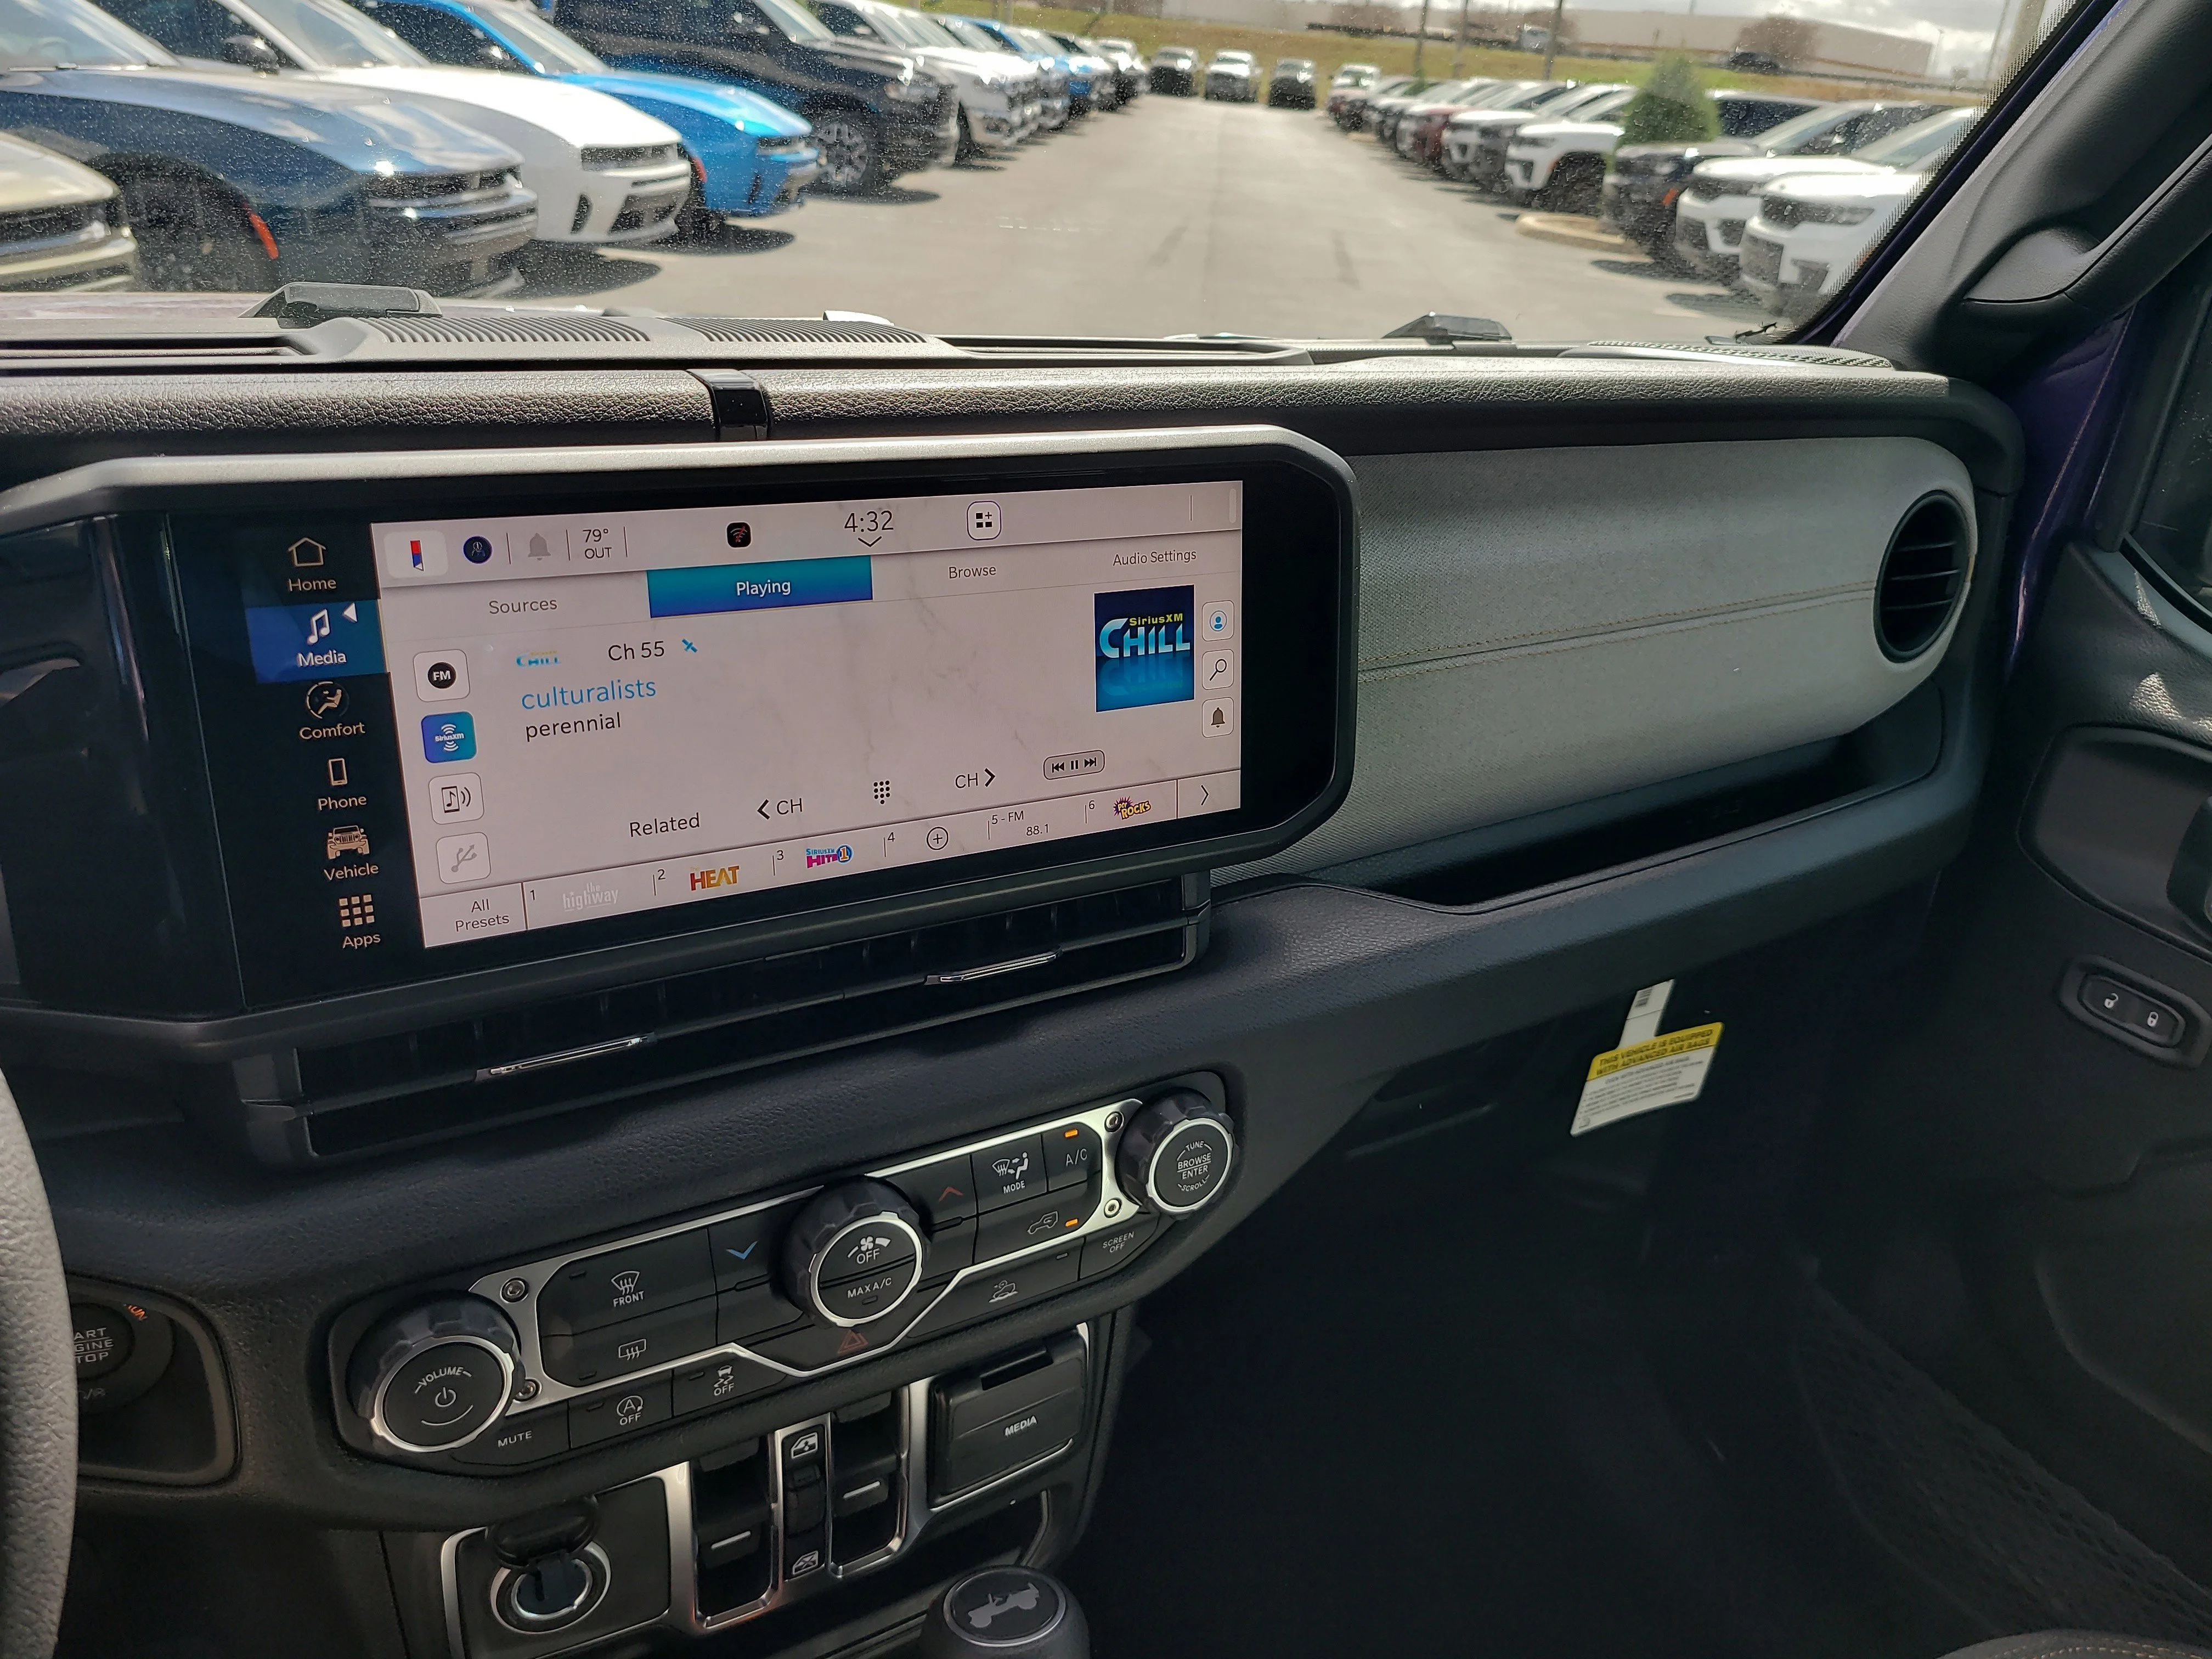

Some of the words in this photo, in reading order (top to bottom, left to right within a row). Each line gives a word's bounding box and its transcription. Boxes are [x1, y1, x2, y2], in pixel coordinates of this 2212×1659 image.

[844, 510, 895, 533] 4:32
[583, 528, 610, 543] 79°
[584, 547, 612, 559] OUT
[1113, 552, 1148, 566] Audio
[1150, 549, 1197, 563] Settings
[948, 566, 996, 579] Browse
[289, 578, 336, 591] Home
[736, 579, 791, 597] Playing
[489, 600, 557, 614] Sources
[1129, 613, 1183, 626] SiriusXM
[1099, 617, 1190, 658] CHILL
[297, 650, 347, 667] Media
[608, 643, 635, 661] Ch
[641, 641, 664, 658] 55
[432, 670, 452, 681] FM
[522, 679, 656, 709] culturalists
[300, 722, 366, 740] Comfort
[526, 712, 620, 742] perennial
[955, 772, 979, 789] CH
[317, 794, 368, 811] Phone
[776, 797, 803, 815] CH
[1088, 799, 1096, 811] 6
[1121, 801, 1150, 819] ROCKS
[630, 812, 700, 838] Related
[991, 814, 998, 825] 5
[1007, 810, 1025, 823] FM
[887, 831, 896, 843] 4
[1025, 823, 1050, 837] 88.1
[776, 849, 785, 861] 3
[324, 862, 379, 881] Vehicle
[657, 868, 667, 881] 2
[690, 865, 740, 891] HEAT
[529, 889, 536, 901] 1
[562, 889, 619, 910] highway
[471, 898, 489, 913] All
[455, 915, 510, 932] Presets
[342, 934, 381, 950] Apps
[1186, 1141, 1204, 1151] TUNE
[1065, 1147, 1088, 1167] A/C
[1178, 1152, 1211, 1170] BROWSE
[1182, 1165, 1208, 1180] ENTER
[1003, 1180, 1025, 1194] MODE
[1181, 1179, 1207, 1192] SCROLL
[1102, 1231, 1135, 1249] SCREEN
[1108, 1241, 1126, 1254] OFF
[856, 1248, 881, 1265] OFF
[847, 1283, 871, 1299] MAX
[872, 1277, 893, 1292] A/C
[612, 1290, 645, 1308] FRONT
[74, 1327, 106, 1340] ART
[76, 1339, 114, 1352] GINE
[75, 1352, 109, 1363] TOP
[417, 1365, 465, 1387] VOLUME
[713, 1382, 736, 1397] OFF
[619, 1411, 642, 1426] OFF
[1004, 1415, 1038, 1436] MEDIA
[497, 1429, 533, 1448] MUTE
